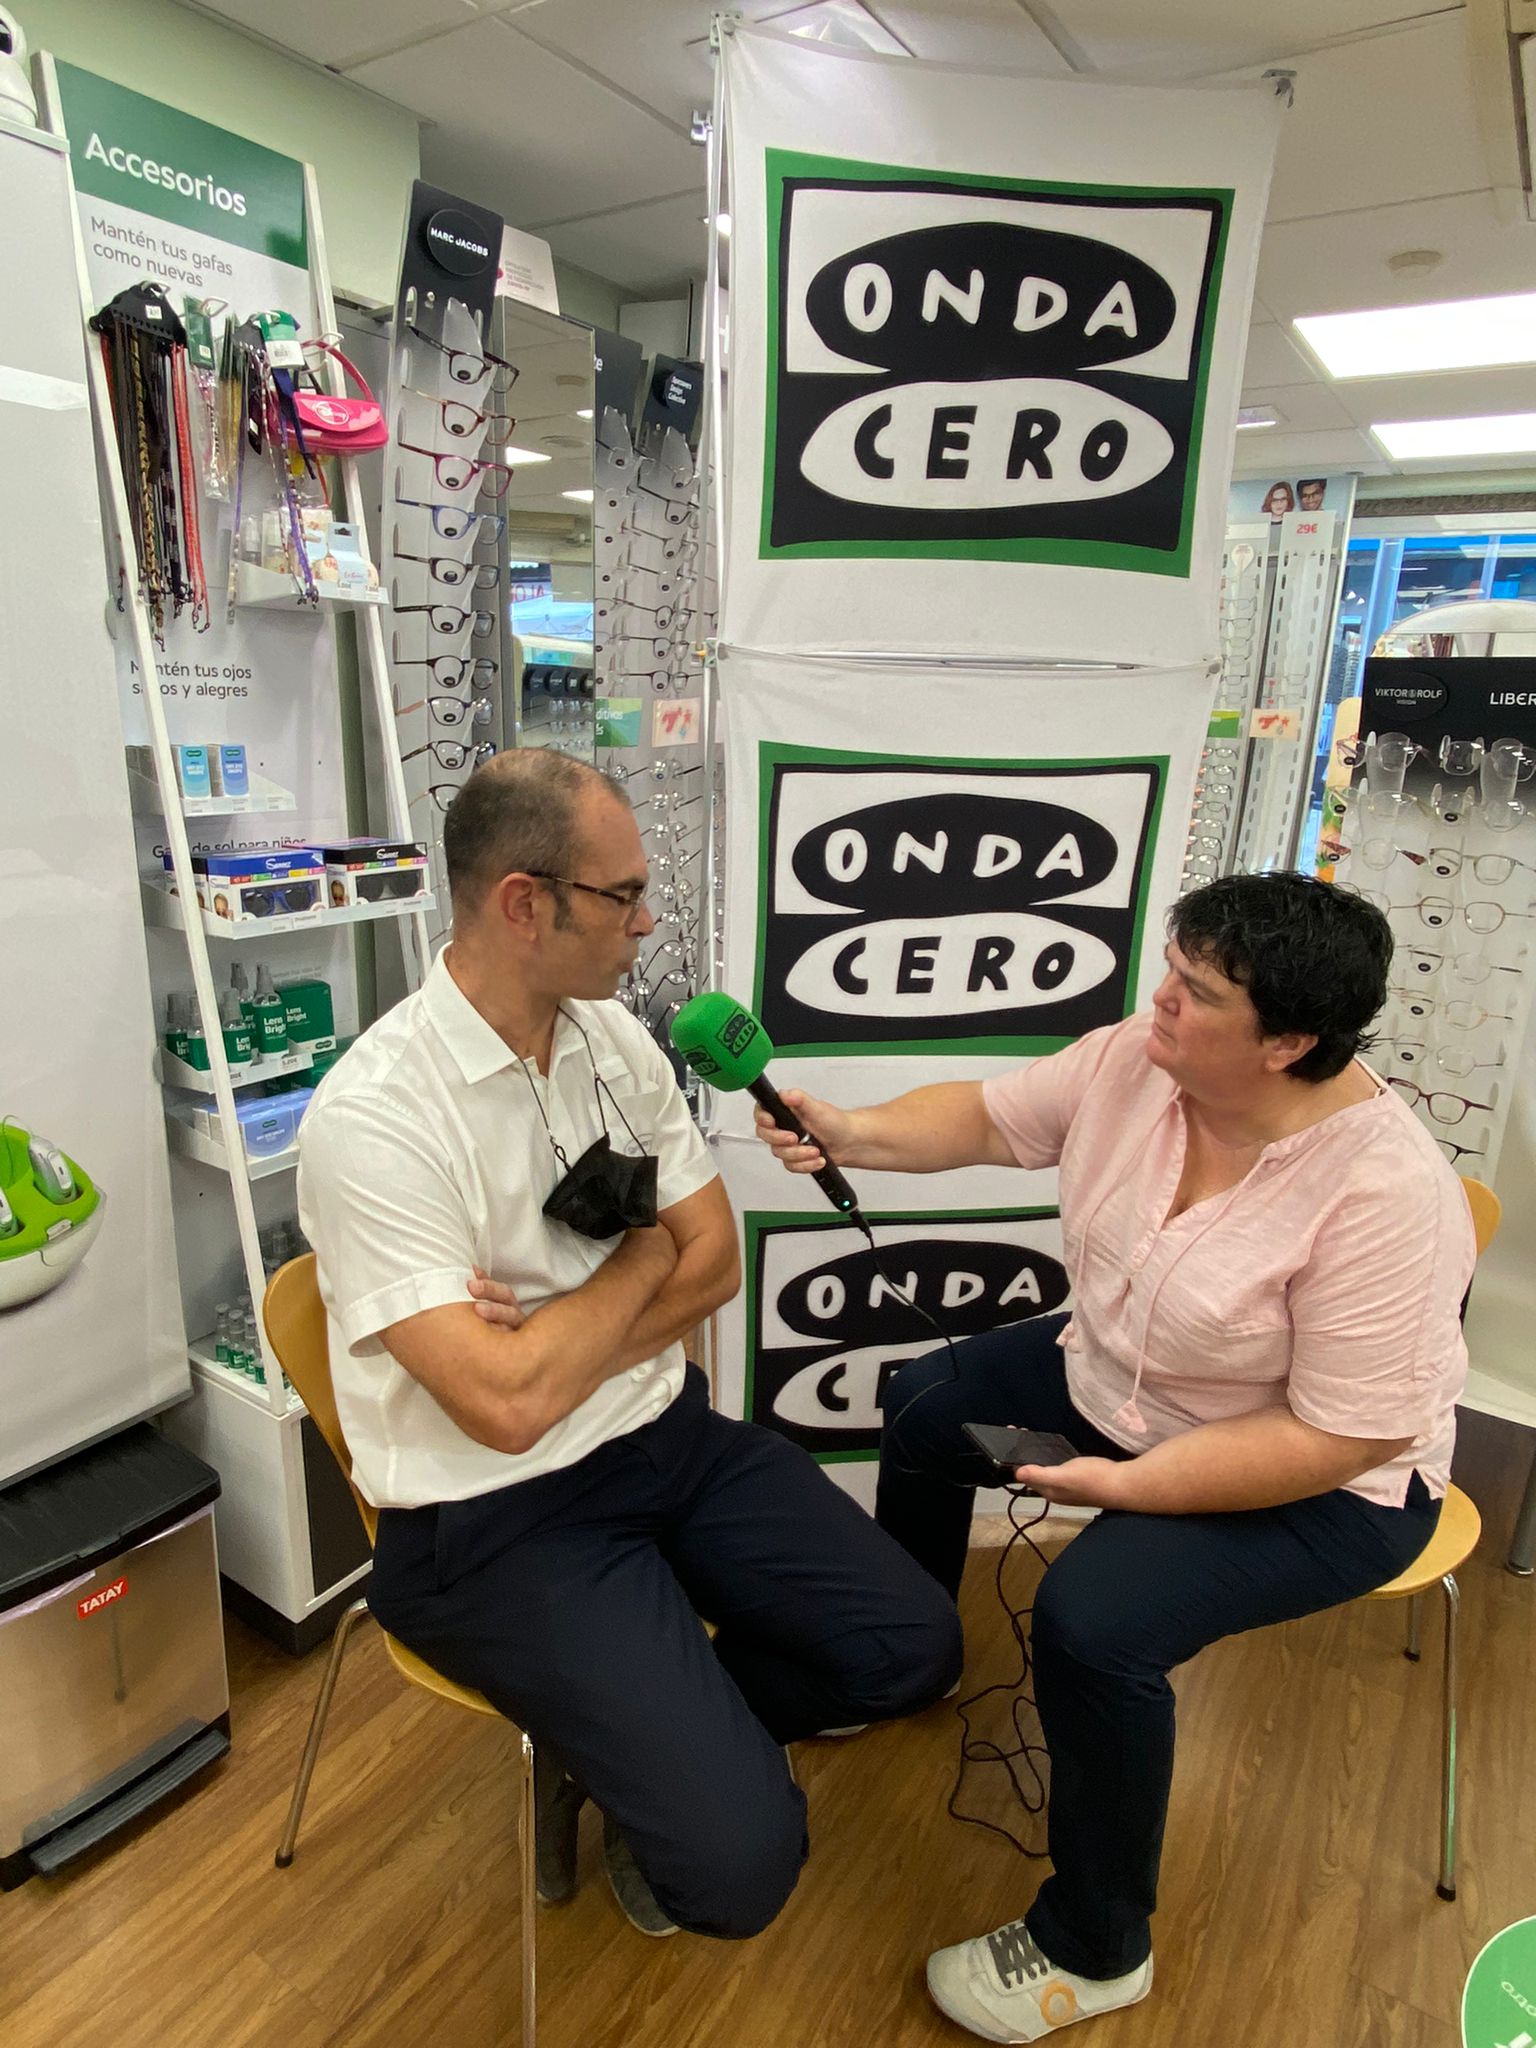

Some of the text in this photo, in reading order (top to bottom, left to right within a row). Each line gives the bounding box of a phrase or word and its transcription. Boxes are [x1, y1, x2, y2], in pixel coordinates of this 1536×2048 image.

[85, 132, 247, 217] Accesorios
[91, 215, 233, 277] Mantén tus gafas
[93, 243, 204, 287] como nuevas
[430, 227, 489, 257] MARC JACOBS
[843, 262, 1138, 338] ONDA
[853, 403, 1129, 482] CERO
[1296, 523, 1319, 534] 29€
[132, 682, 249, 700] sos y alegres
[194, 663, 219, 678] tus
[222, 663, 252, 681] ojos
[824, 828, 1084, 883] ONDA
[833, 936, 1075, 995] CERO
[807, 1267, 1042, 1319] ONDA
[80, 1581, 124, 1613] TATAY
